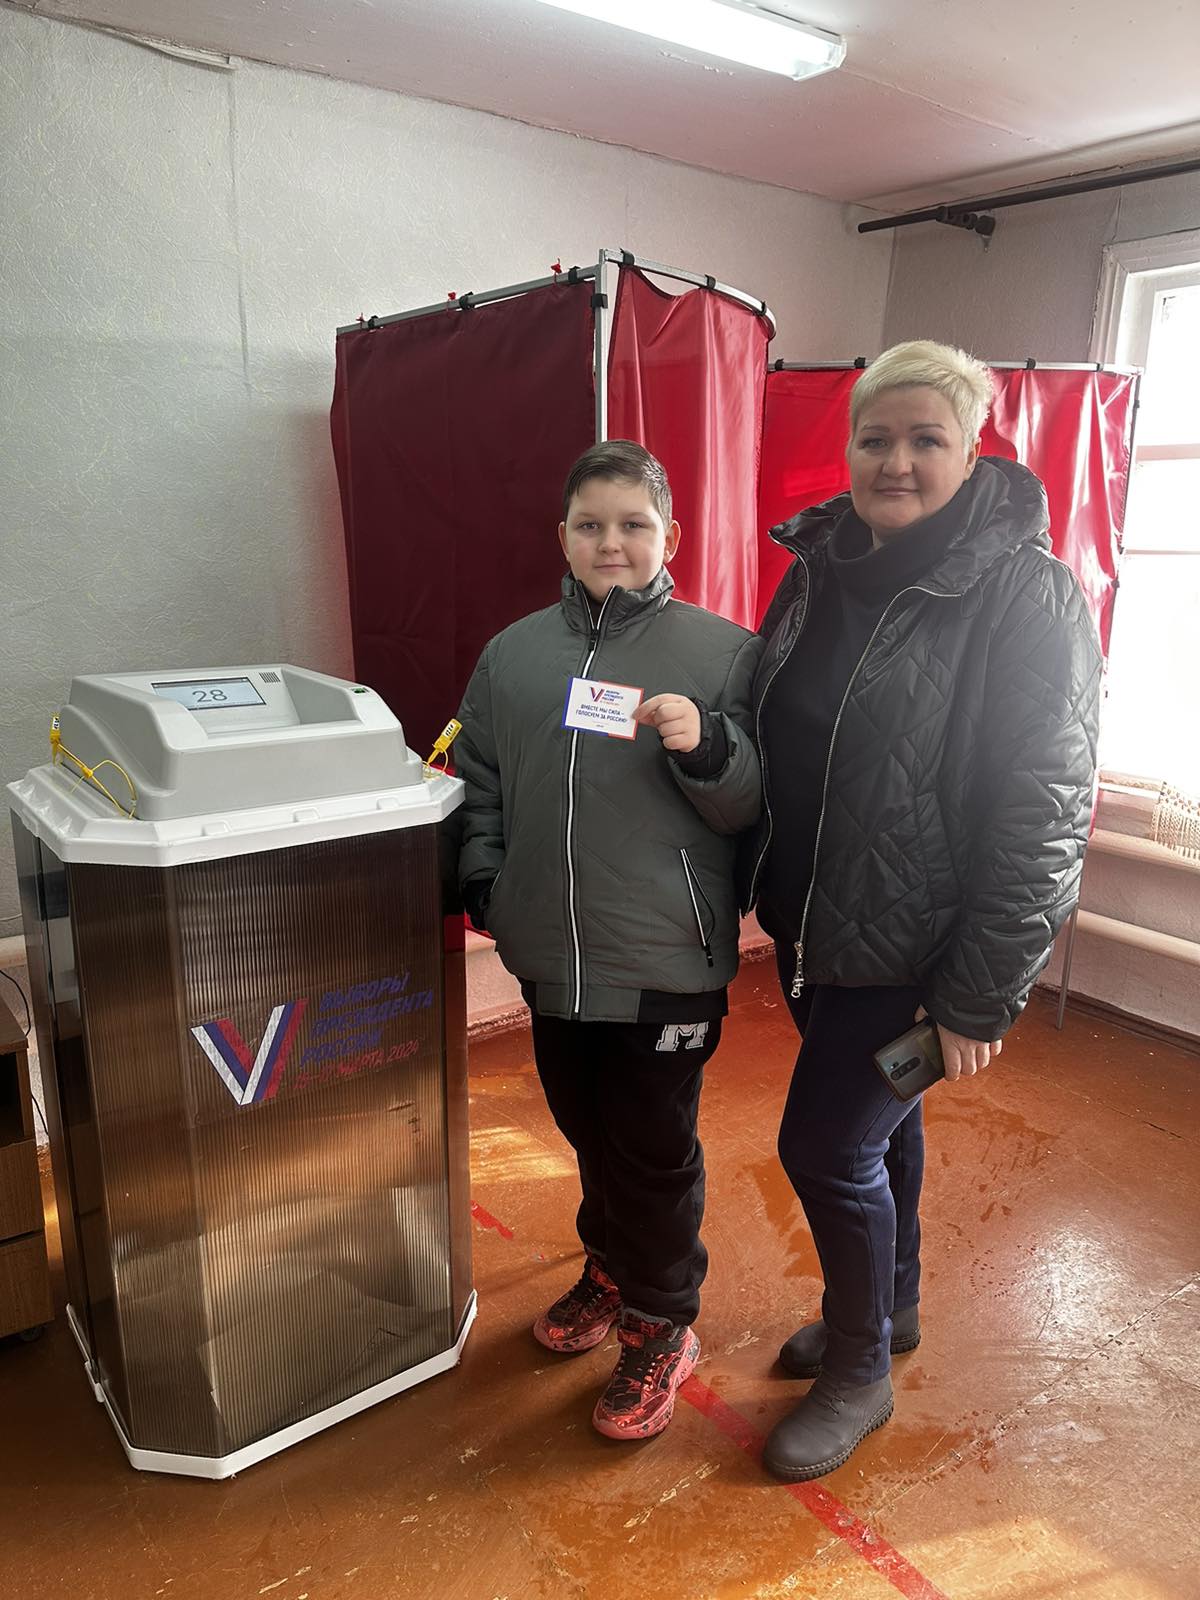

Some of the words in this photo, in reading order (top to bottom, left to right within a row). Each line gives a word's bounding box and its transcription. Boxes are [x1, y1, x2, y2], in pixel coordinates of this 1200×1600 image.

[192, 689, 228, 703] 28
[576, 709, 599, 718] ГОЛОСУЕМ
[319, 971, 411, 1012] ВЫБОРЫ
[300, 1030, 384, 1068] РОССИИ
[386, 1039, 420, 1064] 2024
